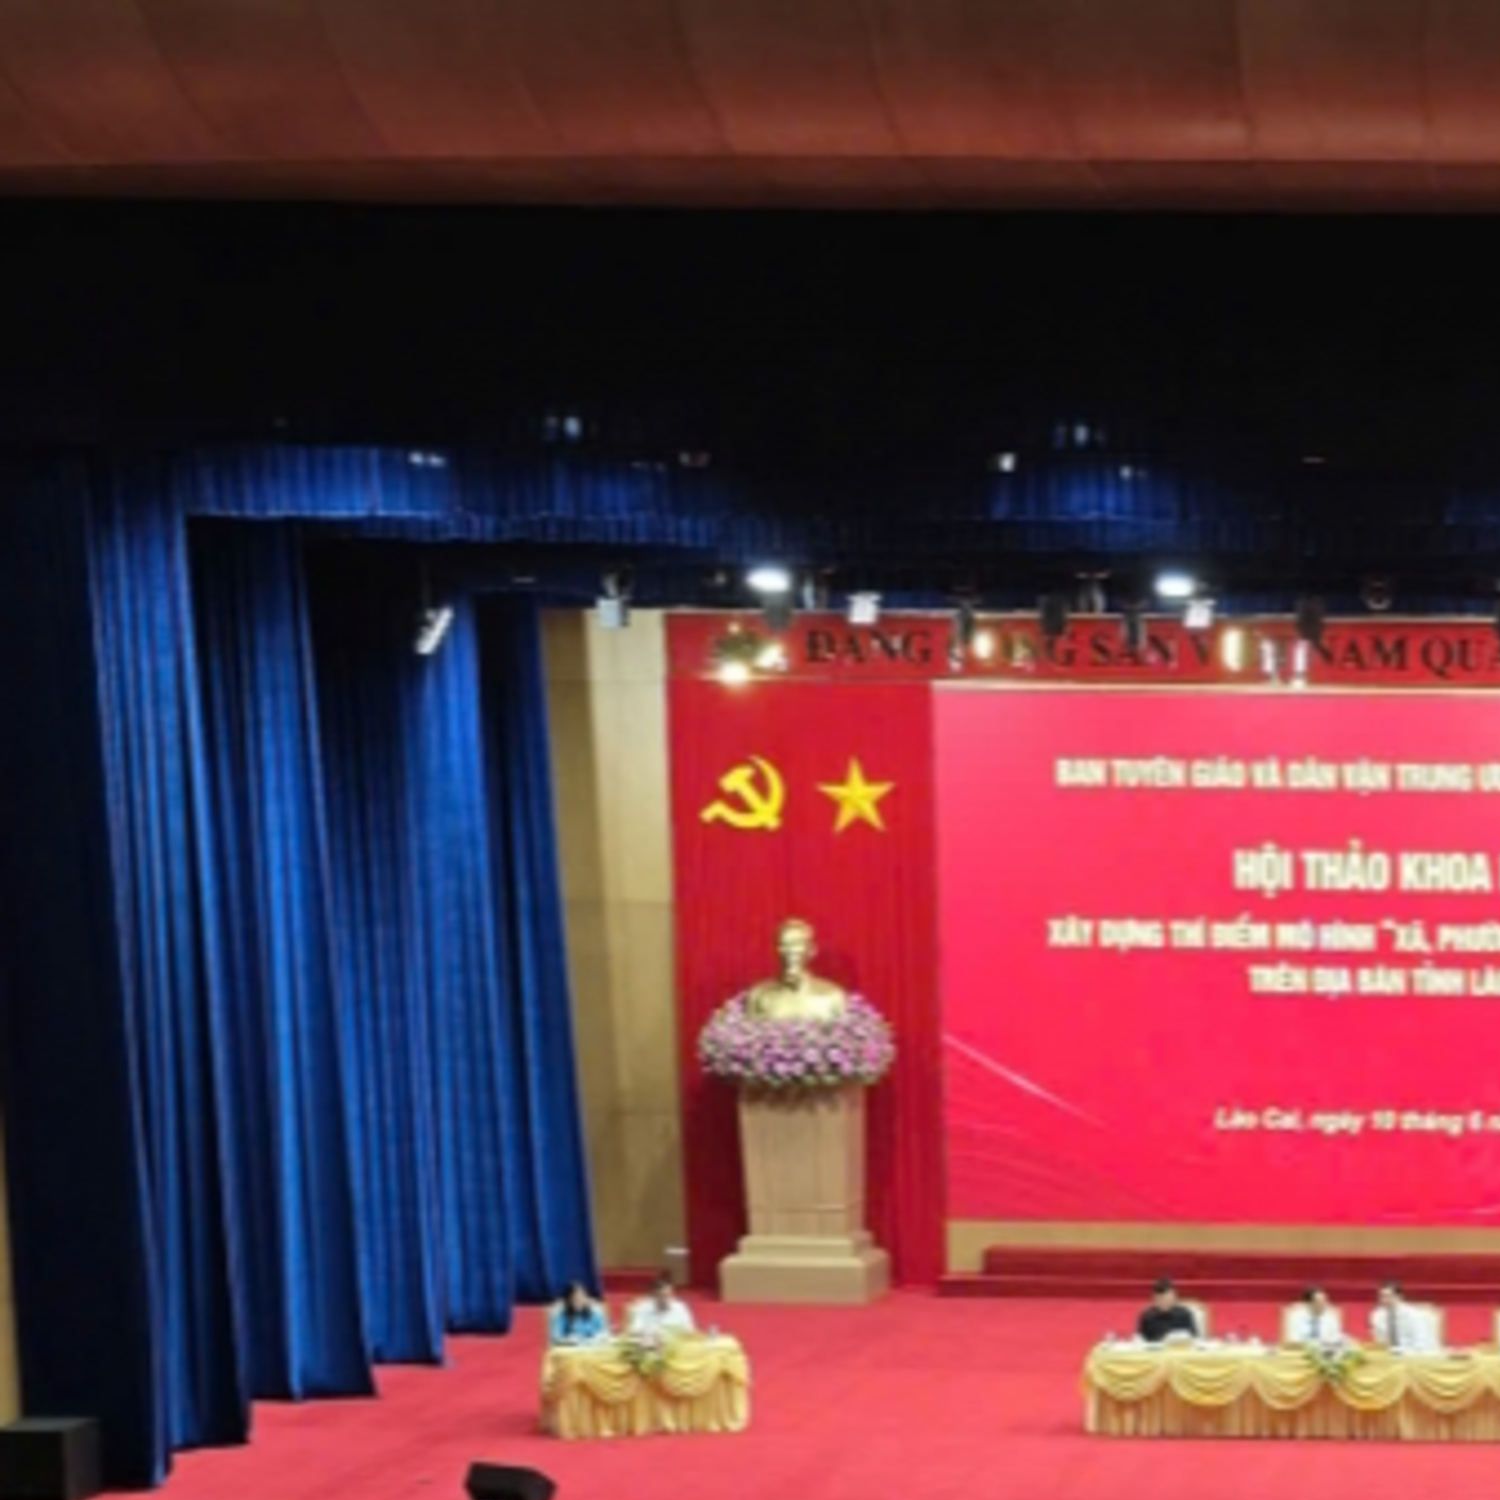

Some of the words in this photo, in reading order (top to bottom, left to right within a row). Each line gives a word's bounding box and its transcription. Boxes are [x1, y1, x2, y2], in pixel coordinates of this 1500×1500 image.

[1233, 841, 1294, 899] HỘI
[1300, 837, 1392, 891] THẢO
[1399, 852, 1493, 892] KHOA
